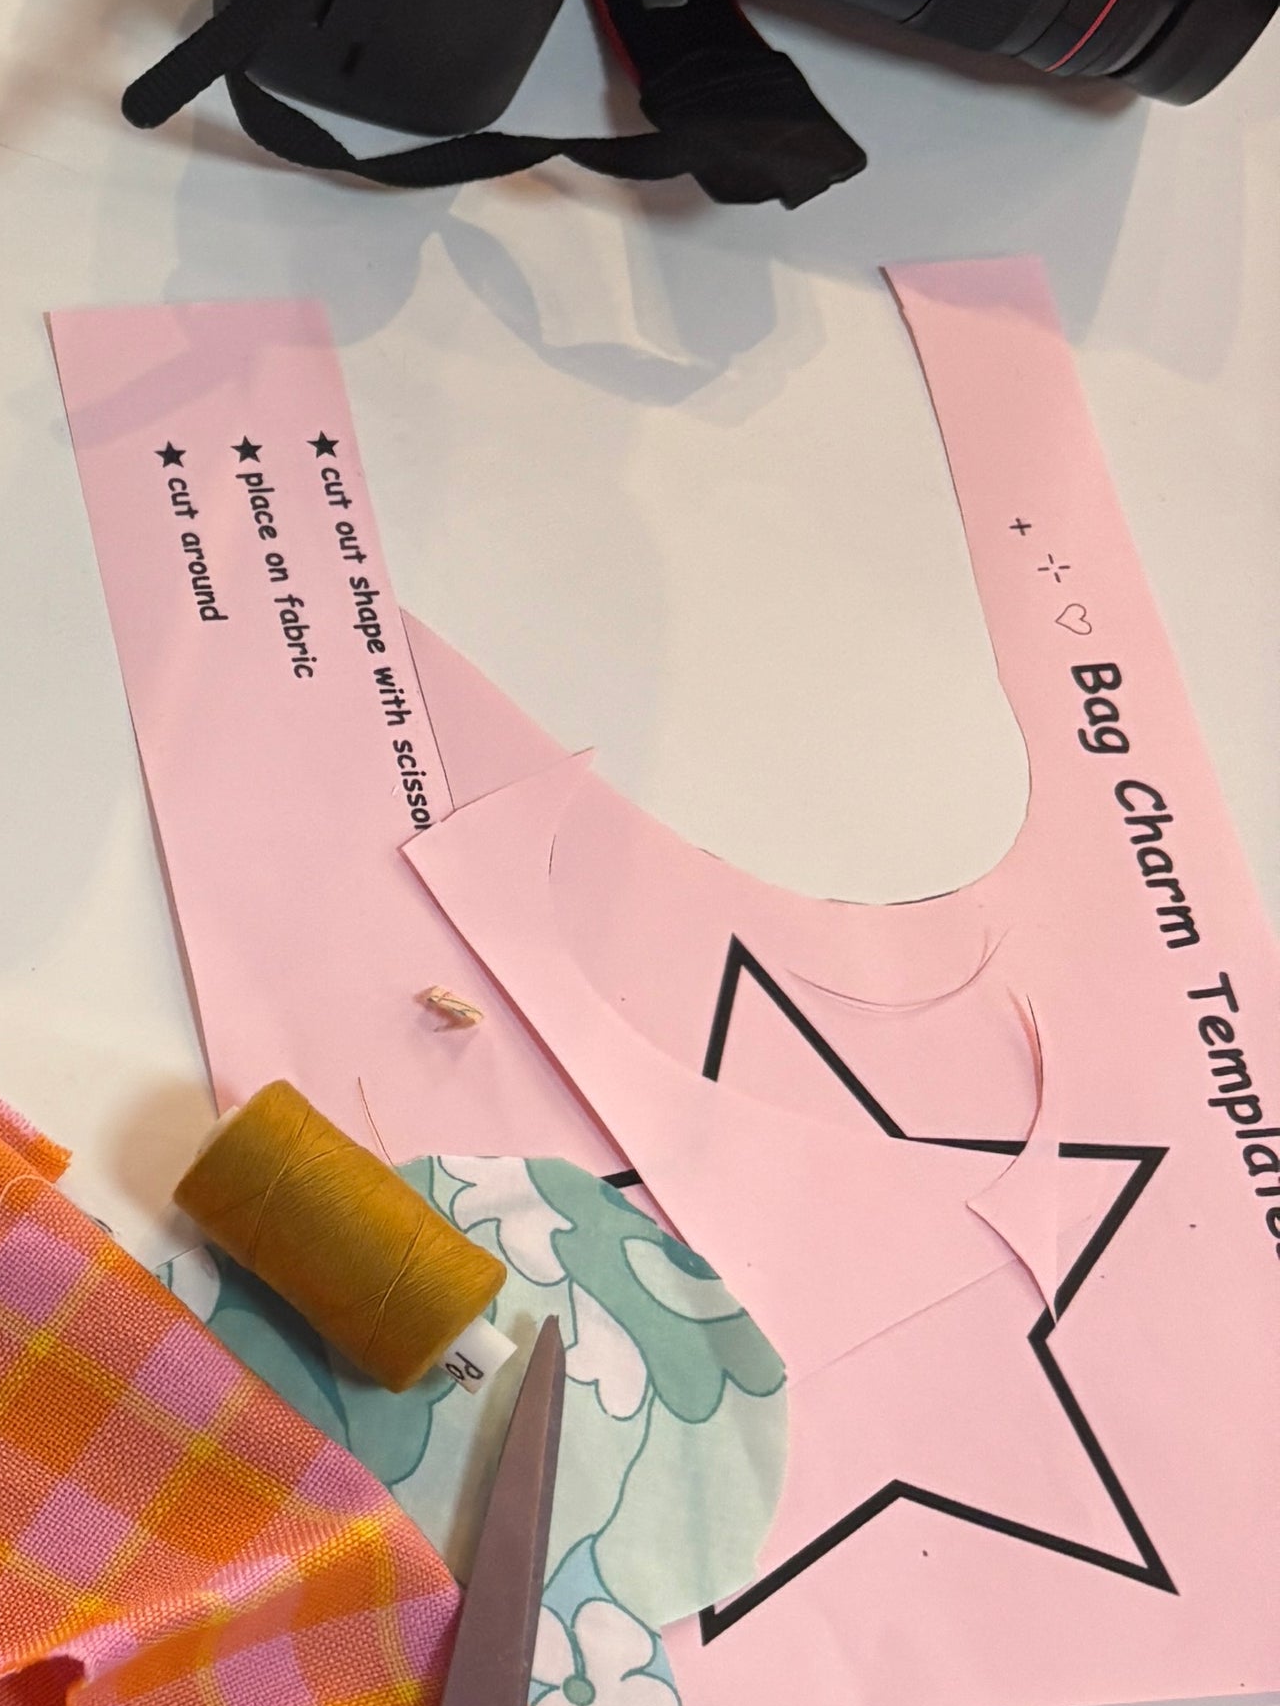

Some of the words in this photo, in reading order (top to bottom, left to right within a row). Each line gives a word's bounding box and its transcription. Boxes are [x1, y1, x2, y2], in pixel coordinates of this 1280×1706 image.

[167, 477, 199, 520] cut
[235, 472, 278, 541] place
[321, 467, 353, 510] cut
[265, 552, 289, 583] on
[335, 521, 367, 564] out
[181, 532, 229, 622] around
[274, 594, 317, 679] fabric
[349, 576, 386, 654] shape
[373, 666, 412, 726] with
[1071, 662, 1130, 754] Bag
[1114, 779, 1200, 949] Charm
[1187, 971, 1280, 1260] Templa
